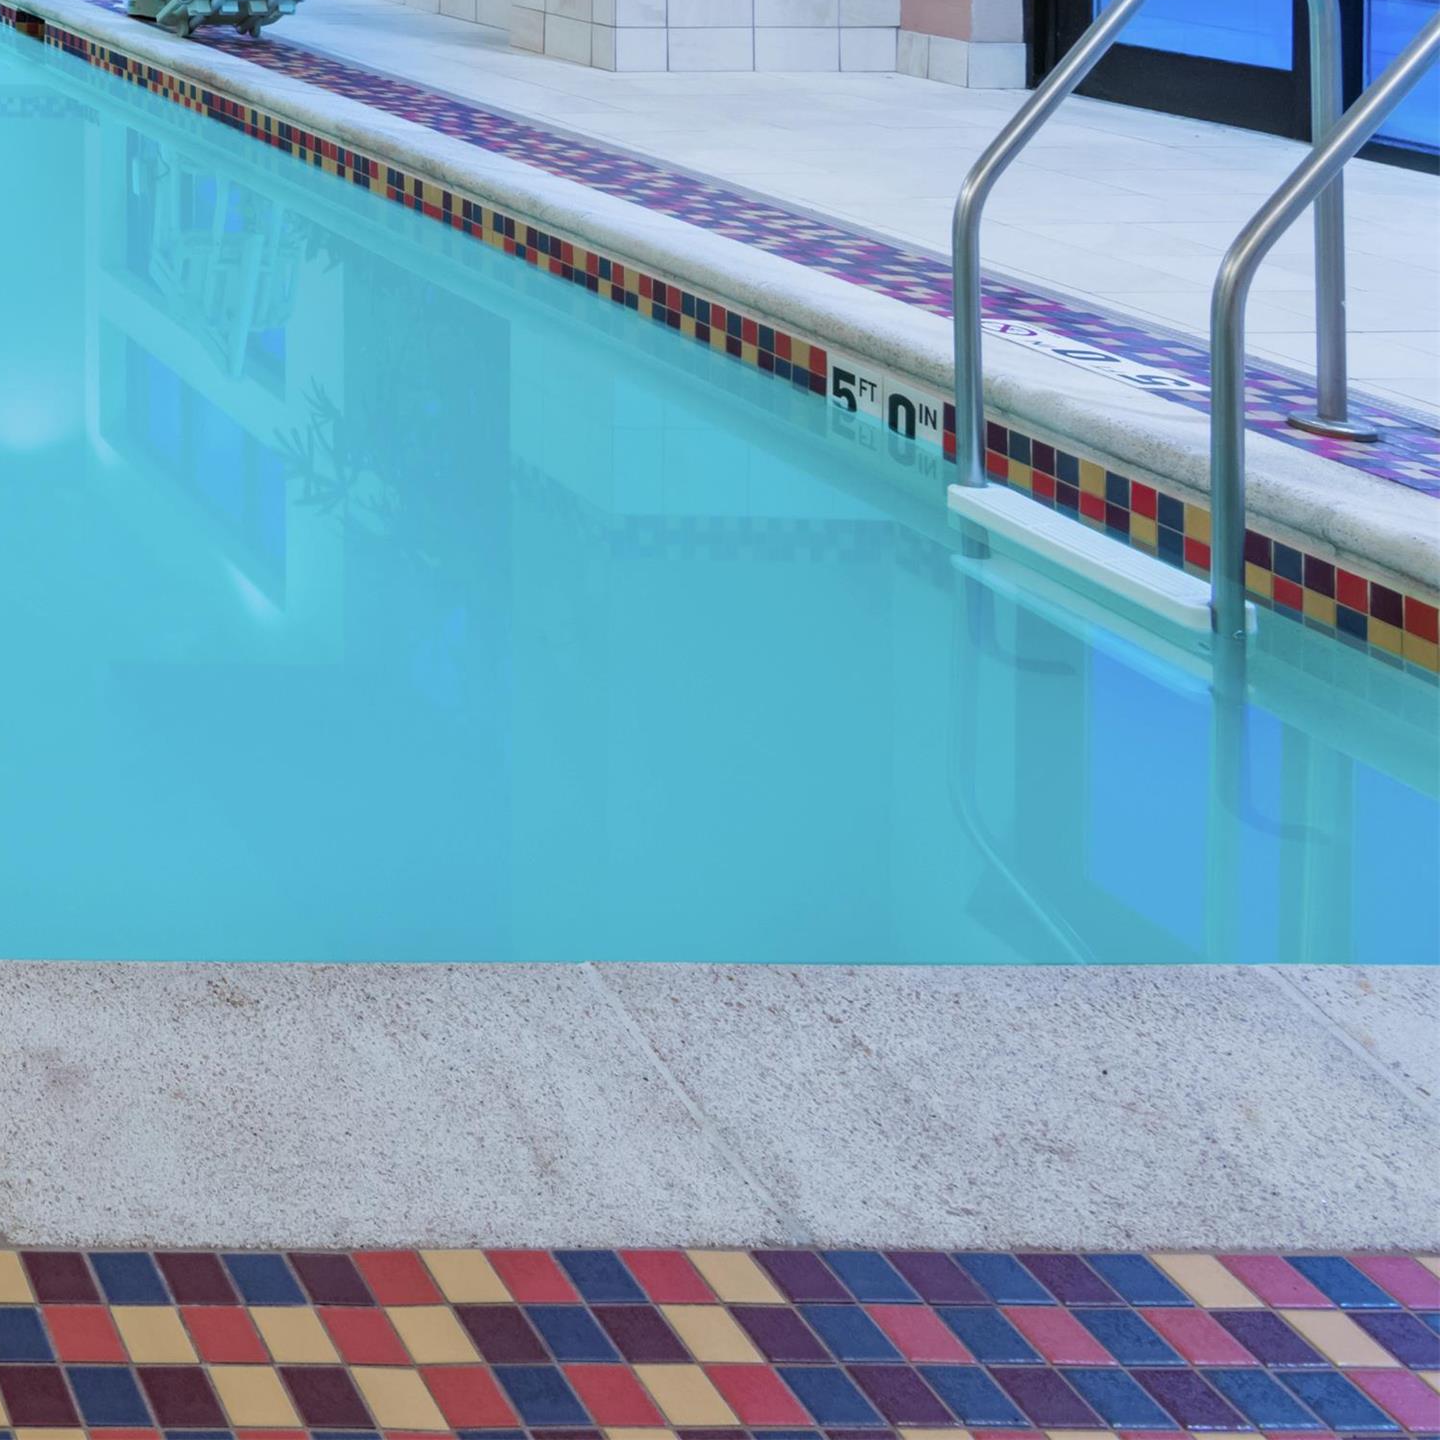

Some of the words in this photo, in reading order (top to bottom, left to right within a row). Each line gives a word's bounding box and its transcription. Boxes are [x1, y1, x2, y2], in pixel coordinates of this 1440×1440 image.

[832, 366, 857, 412] 5
[859, 378, 877, 402] FT
[888, 393, 916, 440] 0
[919, 403, 937, 430] IN
